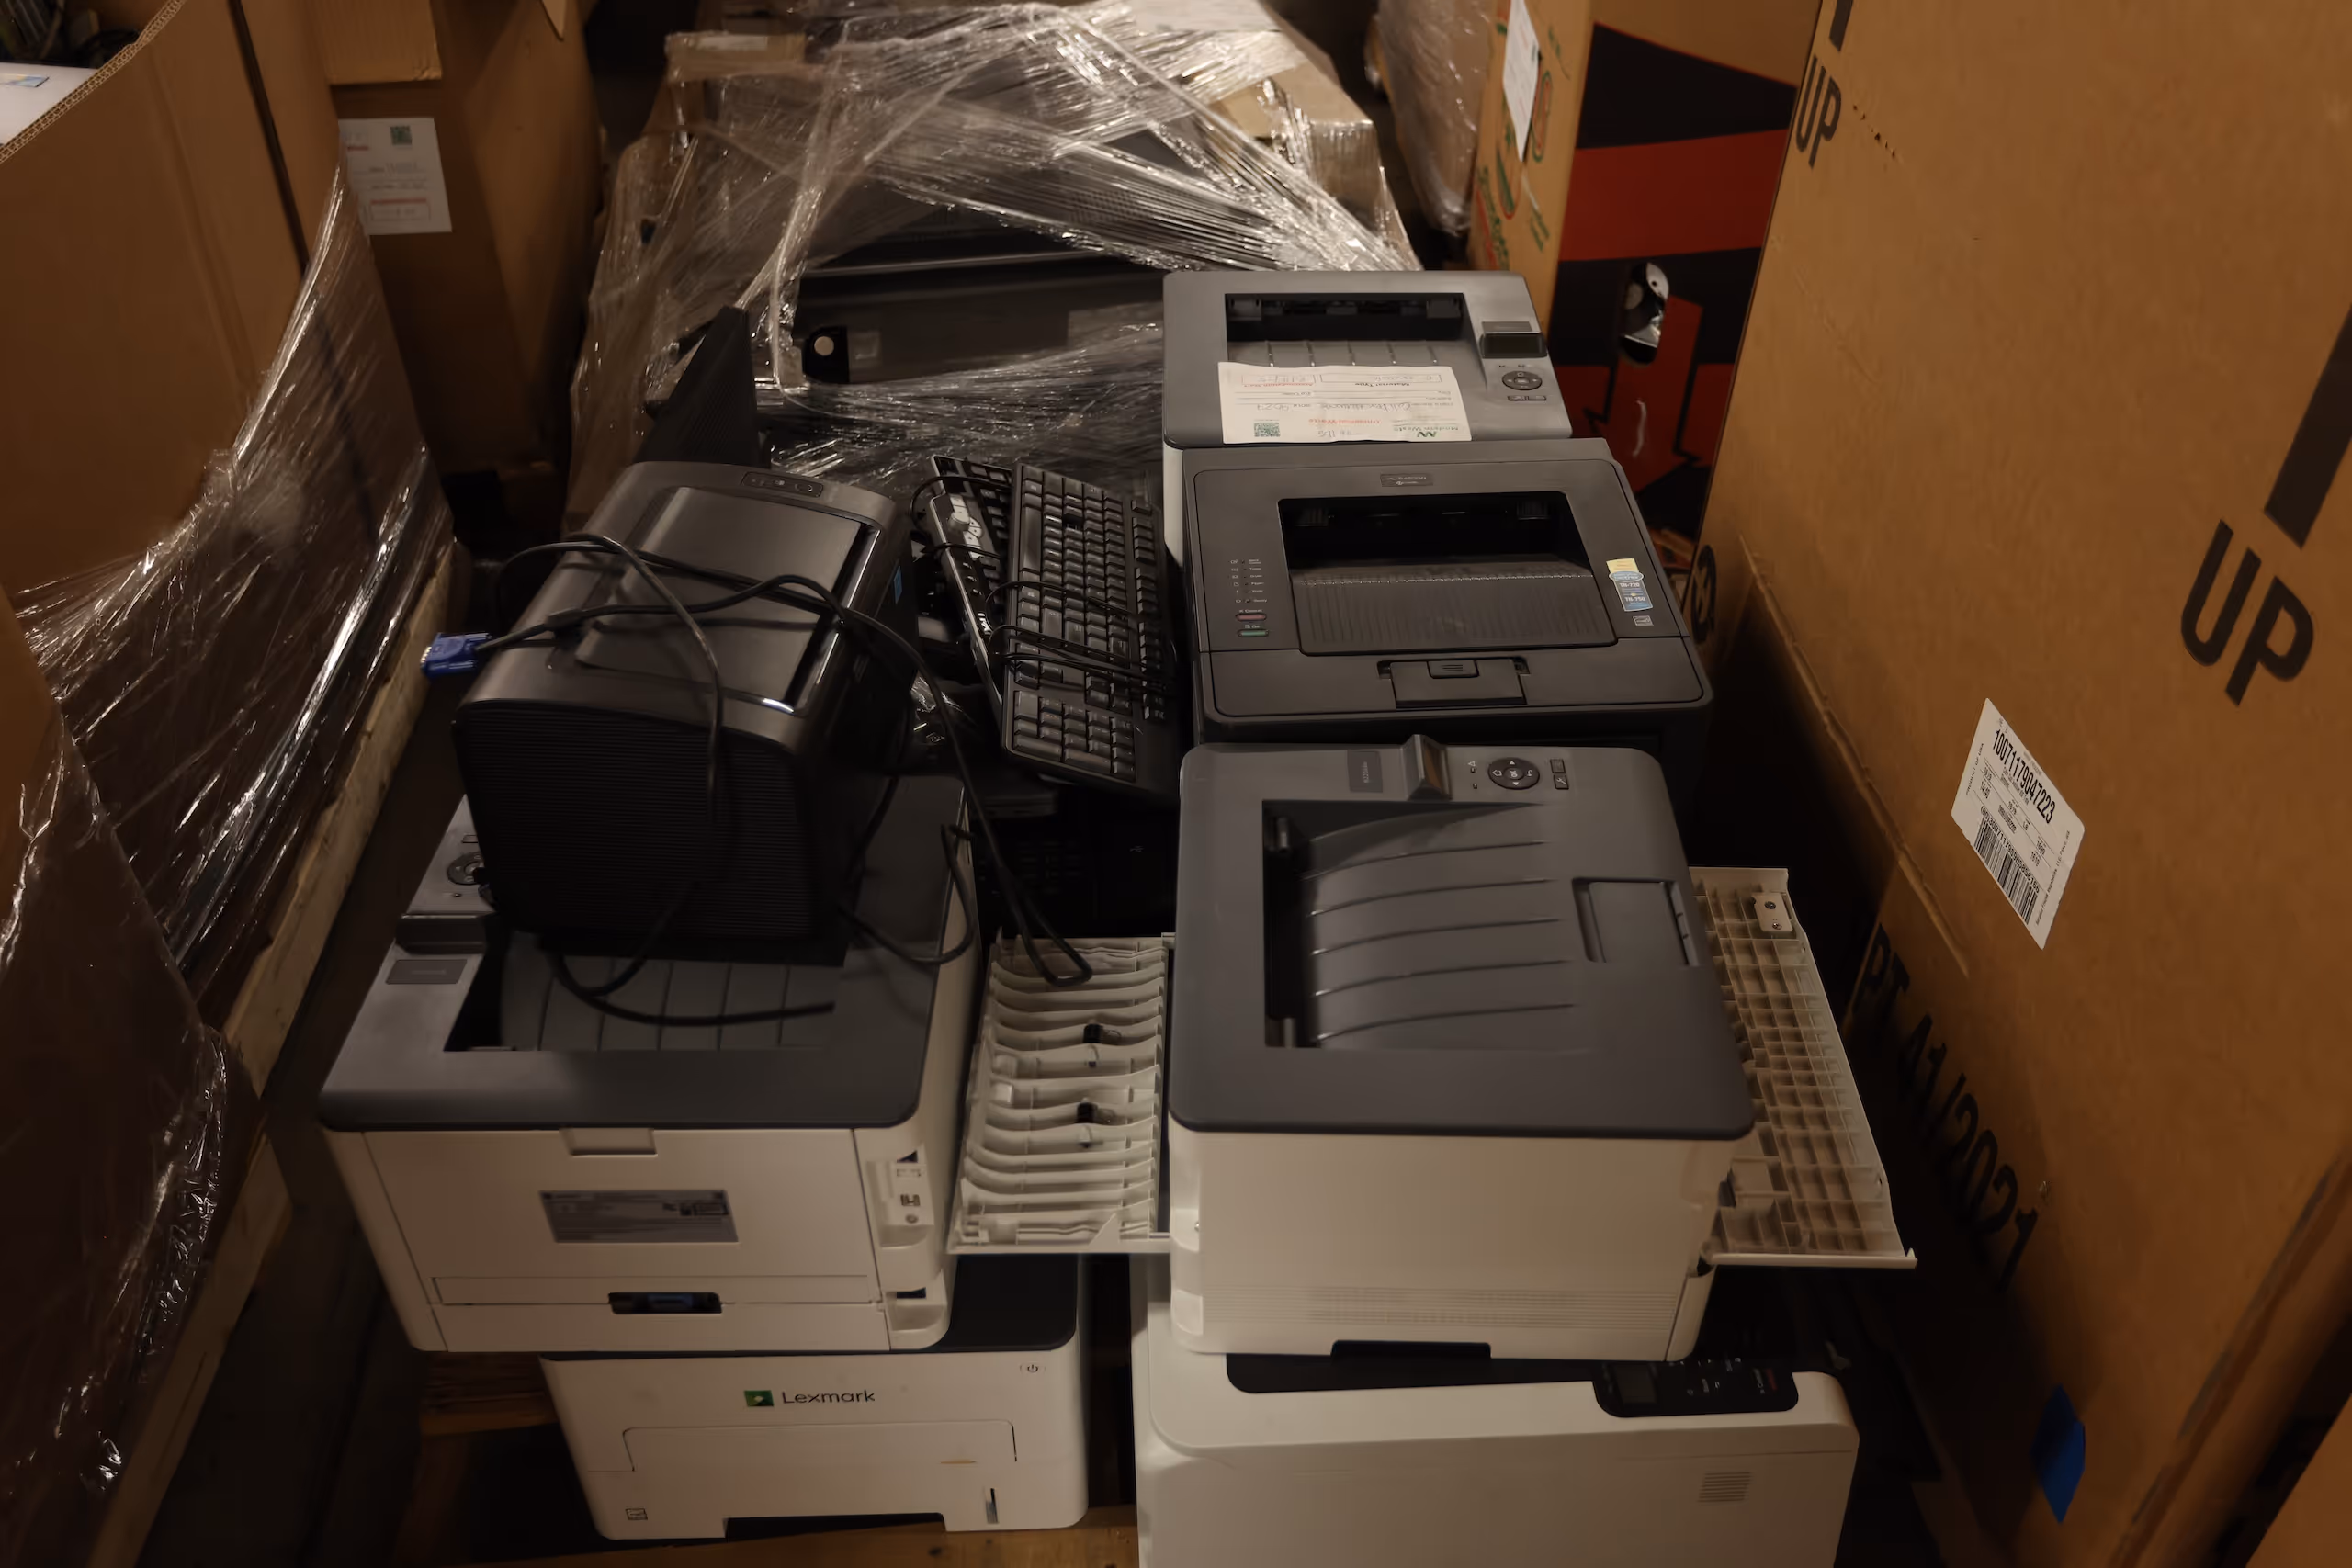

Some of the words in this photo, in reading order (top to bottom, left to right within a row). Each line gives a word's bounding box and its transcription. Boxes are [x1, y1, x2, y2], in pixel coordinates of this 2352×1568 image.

[1796, 54, 1841, 169] UP
[2181, 518, 2313, 706] UP
[1993, 729, 2056, 824] 10071179047223
[782, 1390, 876, 1404] Lexmark
